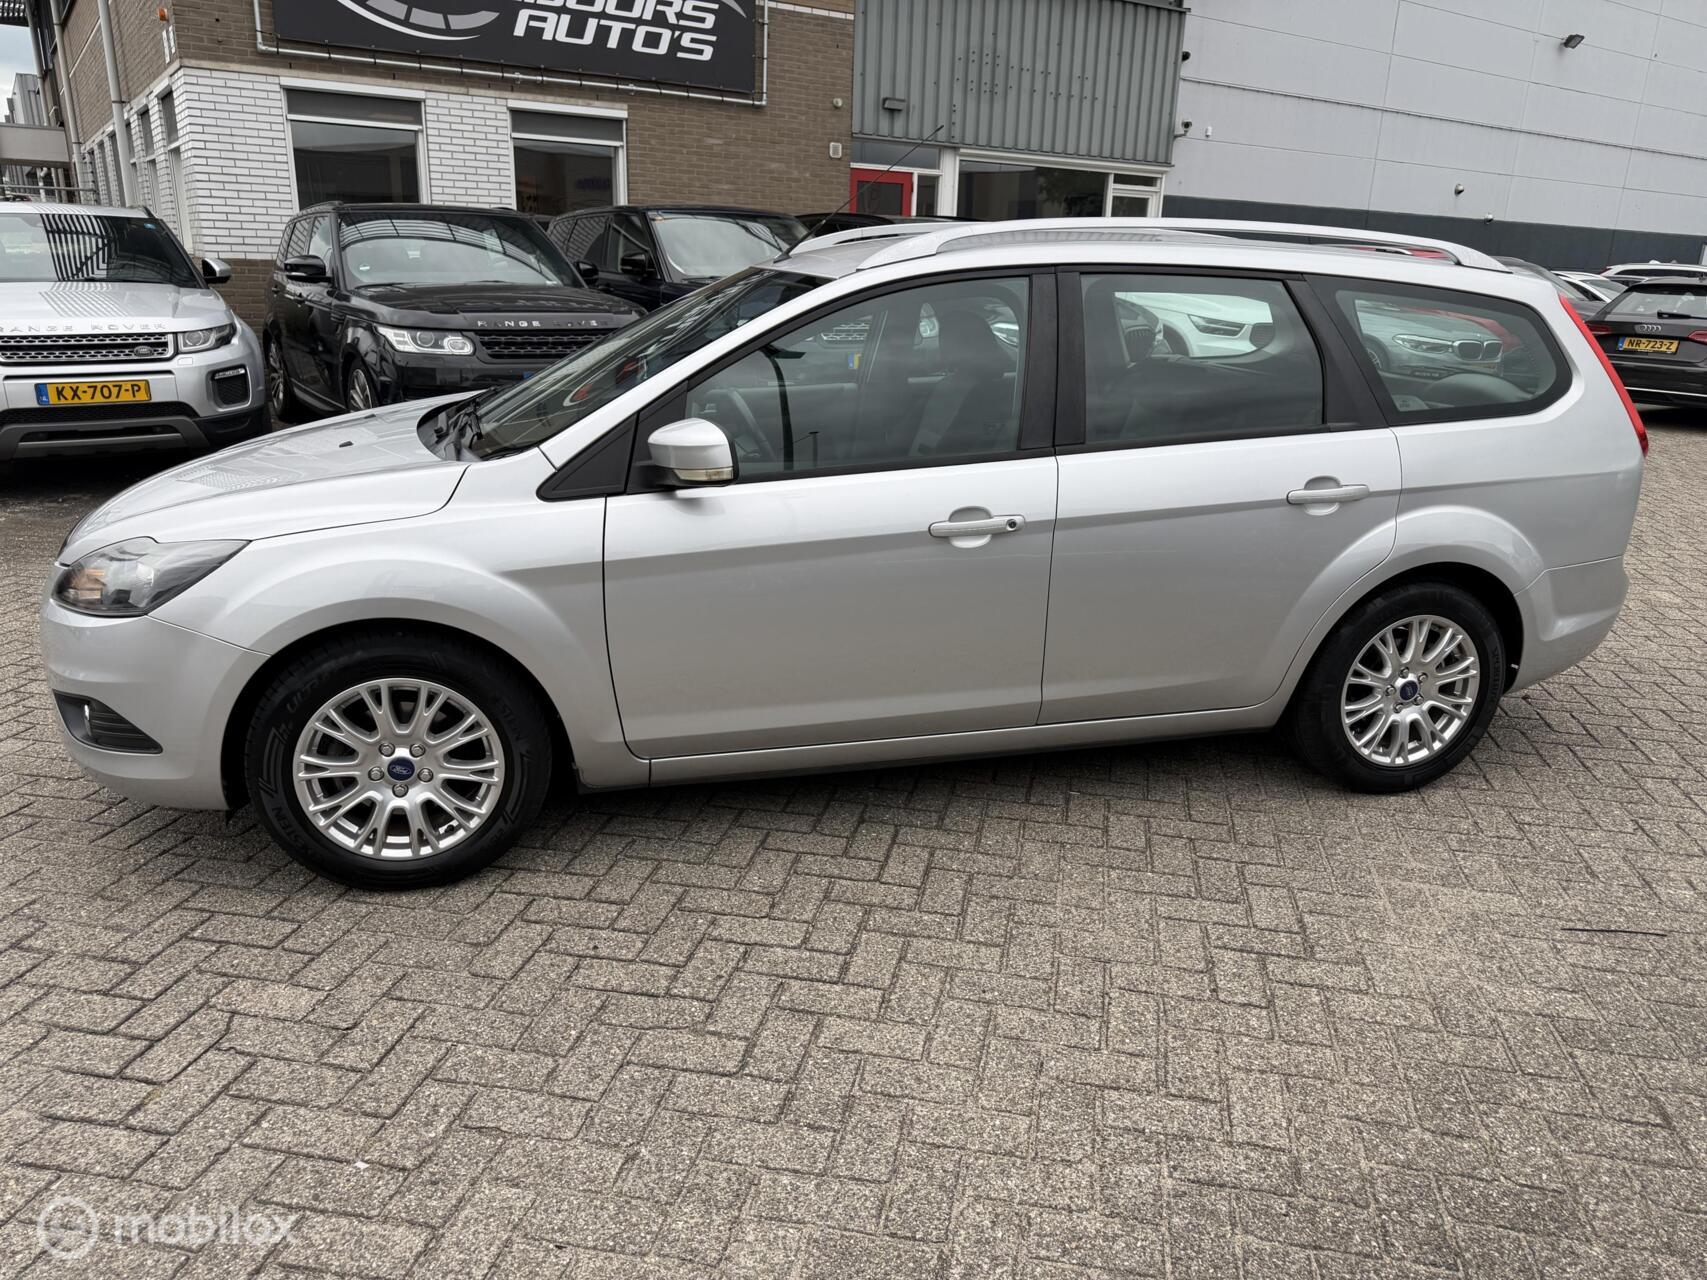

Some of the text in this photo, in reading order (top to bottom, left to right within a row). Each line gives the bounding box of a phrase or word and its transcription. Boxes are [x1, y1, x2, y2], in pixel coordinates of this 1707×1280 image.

[512, 8, 717, 61] AUTO'S
[1627, 338, 1674, 350] NR-723-Z
[55, 383, 142, 401] KX-707-P
